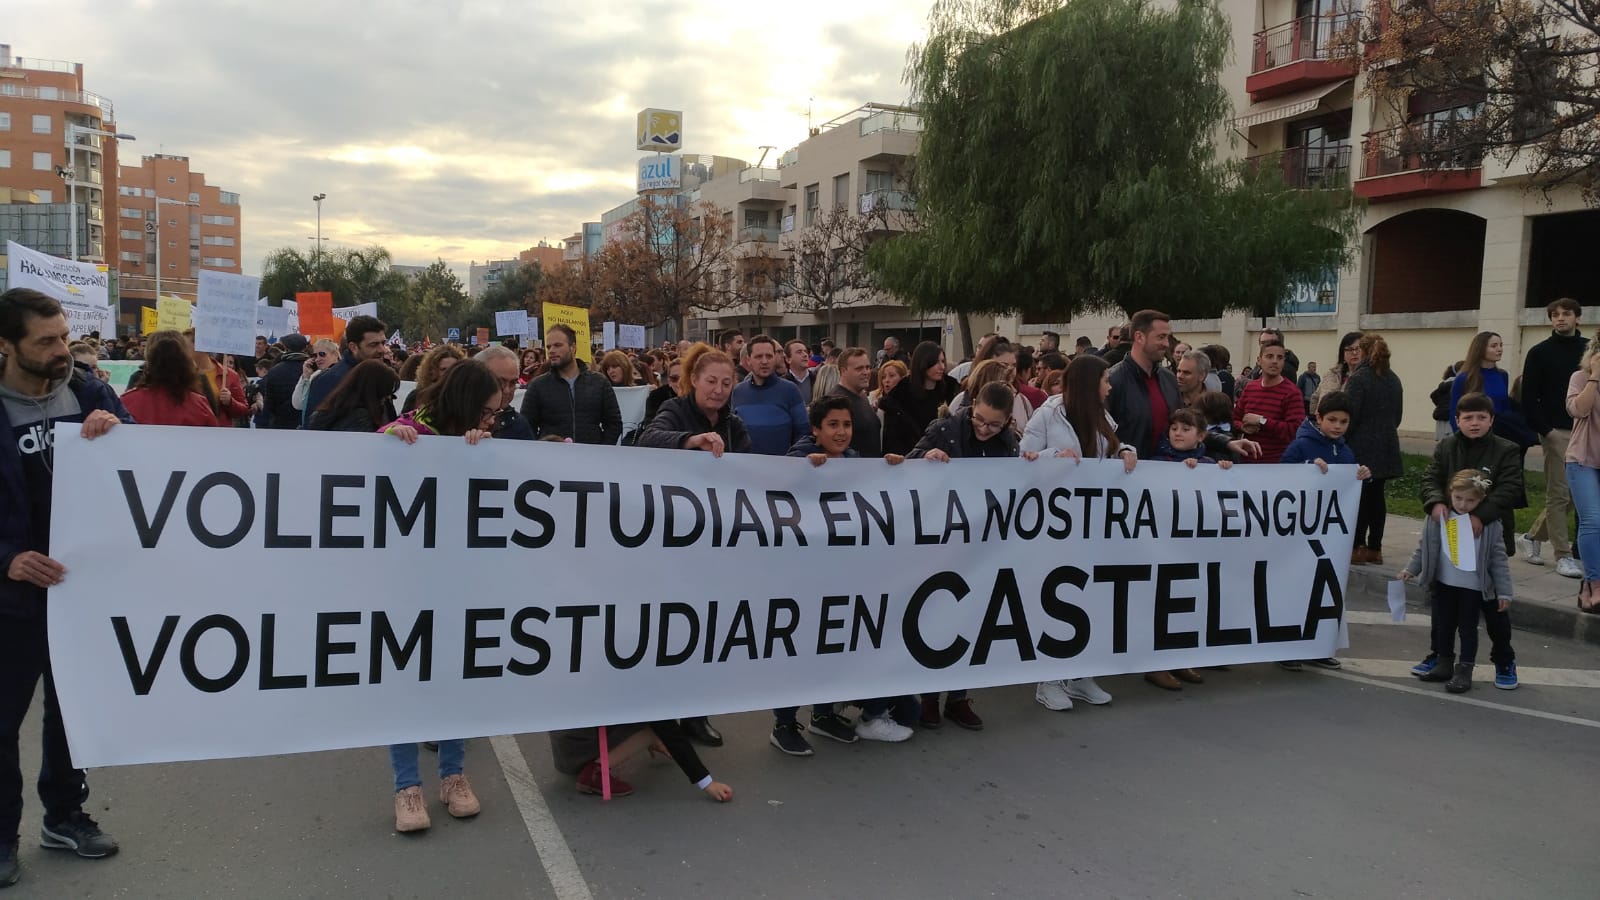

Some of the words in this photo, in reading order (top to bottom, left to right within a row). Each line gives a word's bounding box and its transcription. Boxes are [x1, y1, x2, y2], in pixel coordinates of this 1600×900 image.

[641, 157, 671, 179] azul
[117, 469, 438, 549] VOLEM
[466, 478, 809, 549] ESTUDIAR
[819, 490, 896, 547] EN
[909, 489, 971, 546] LA
[981, 487, 1159, 543] NOSTRA
[1170, 489, 1349, 539] LLENGUA
[111, 609, 434, 696] VOLEM
[462, 597, 801, 680] ESTUDIAR
[815, 593, 889, 656] EN
[901, 540, 1344, 670] CASTELLÀ
